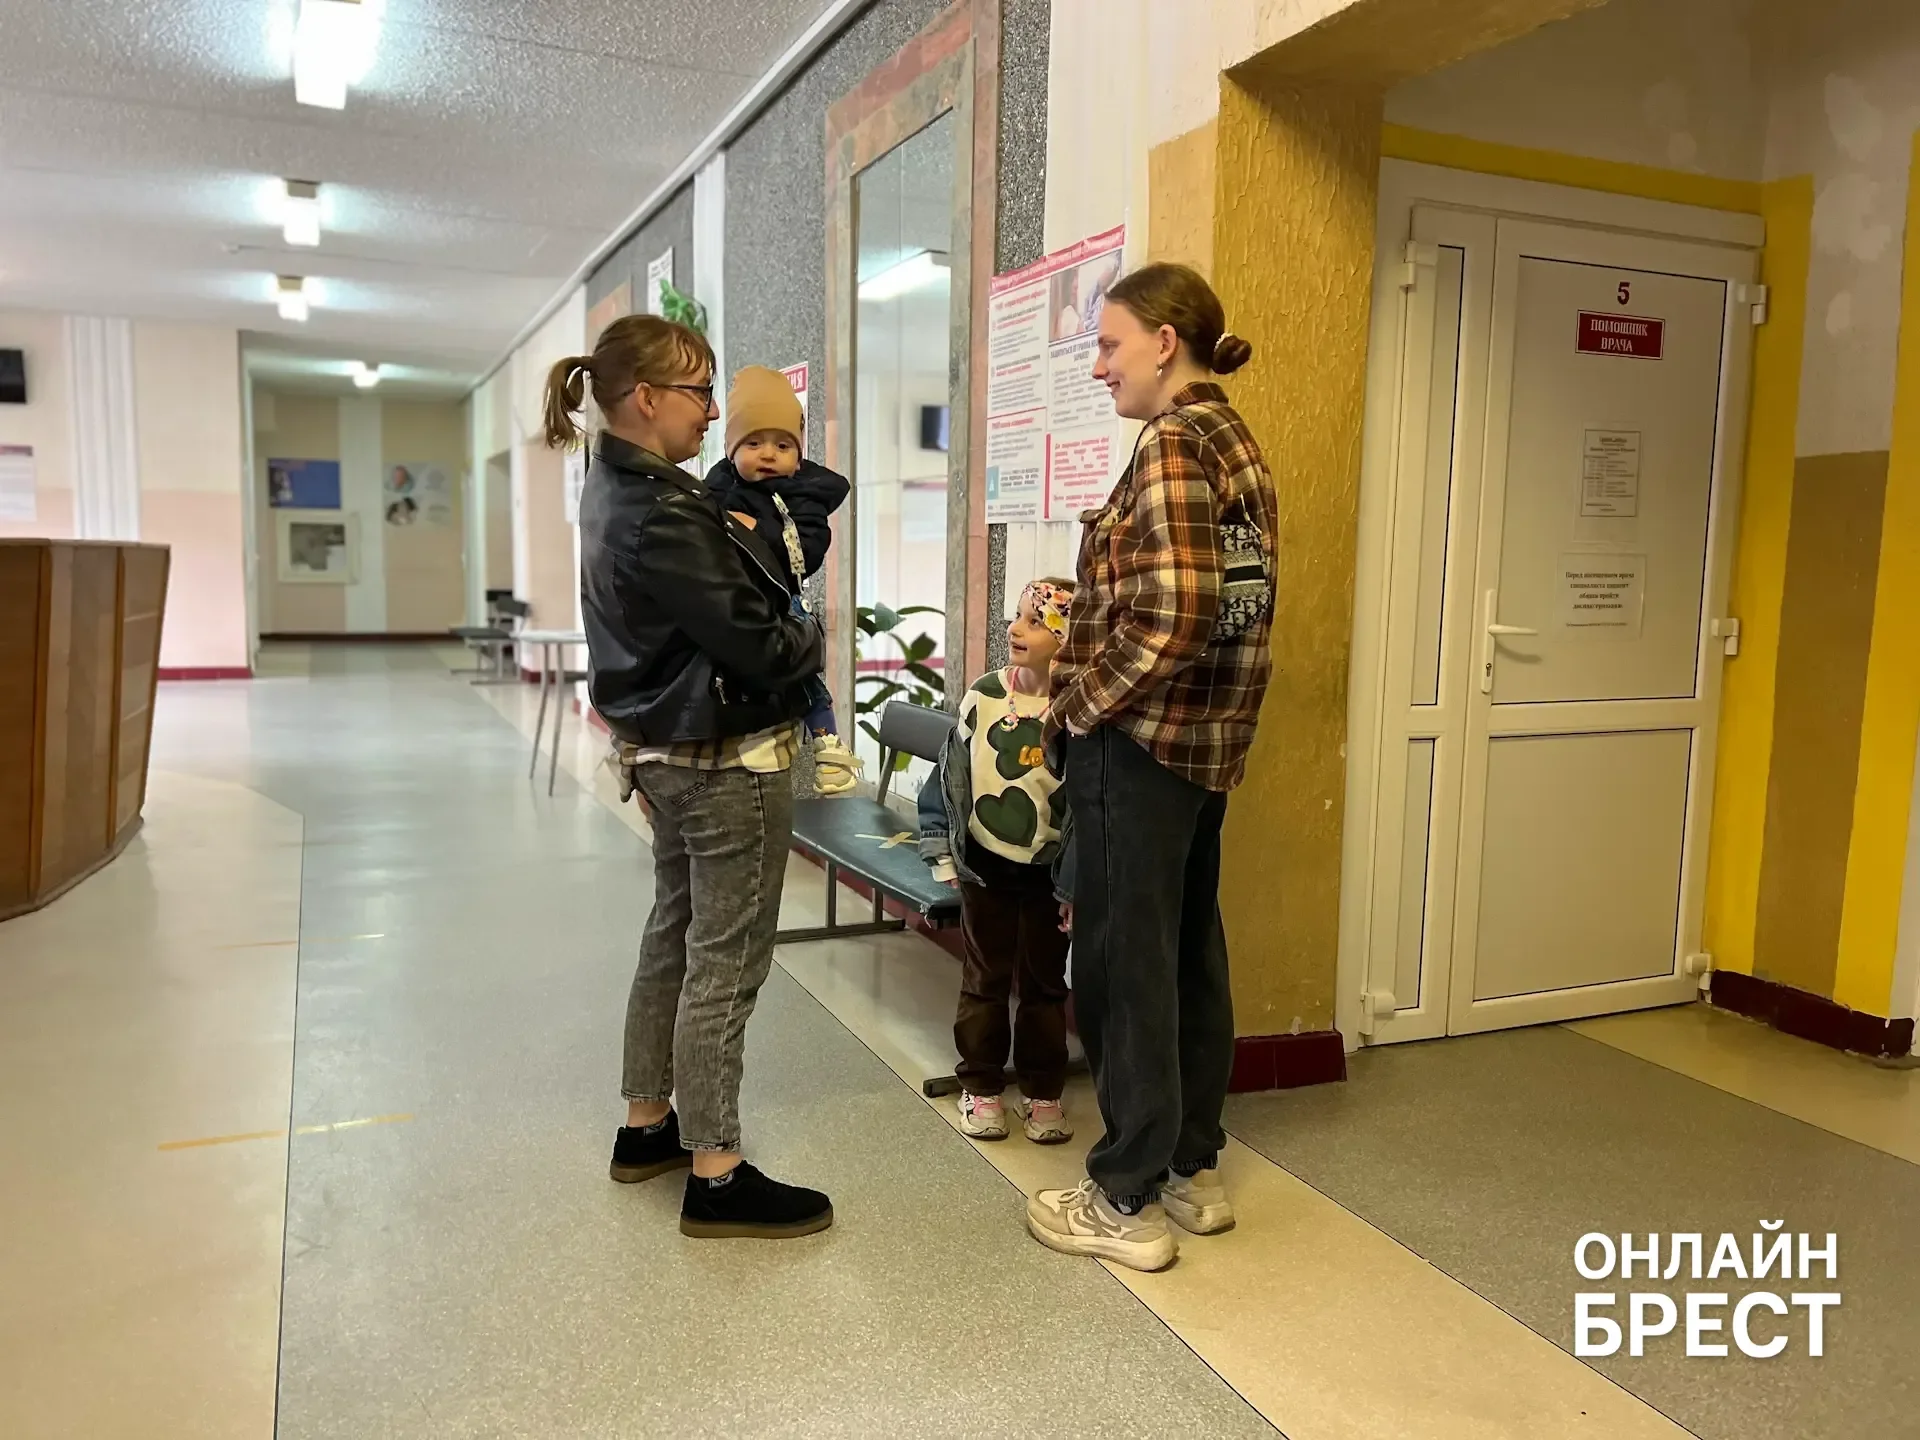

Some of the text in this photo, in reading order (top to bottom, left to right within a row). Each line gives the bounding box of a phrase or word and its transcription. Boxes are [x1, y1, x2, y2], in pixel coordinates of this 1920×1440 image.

[1617, 282, 1630, 305] 5
[1600, 337, 1633, 352] ВРАЧА
[1018, 744, 1044, 767] LO
